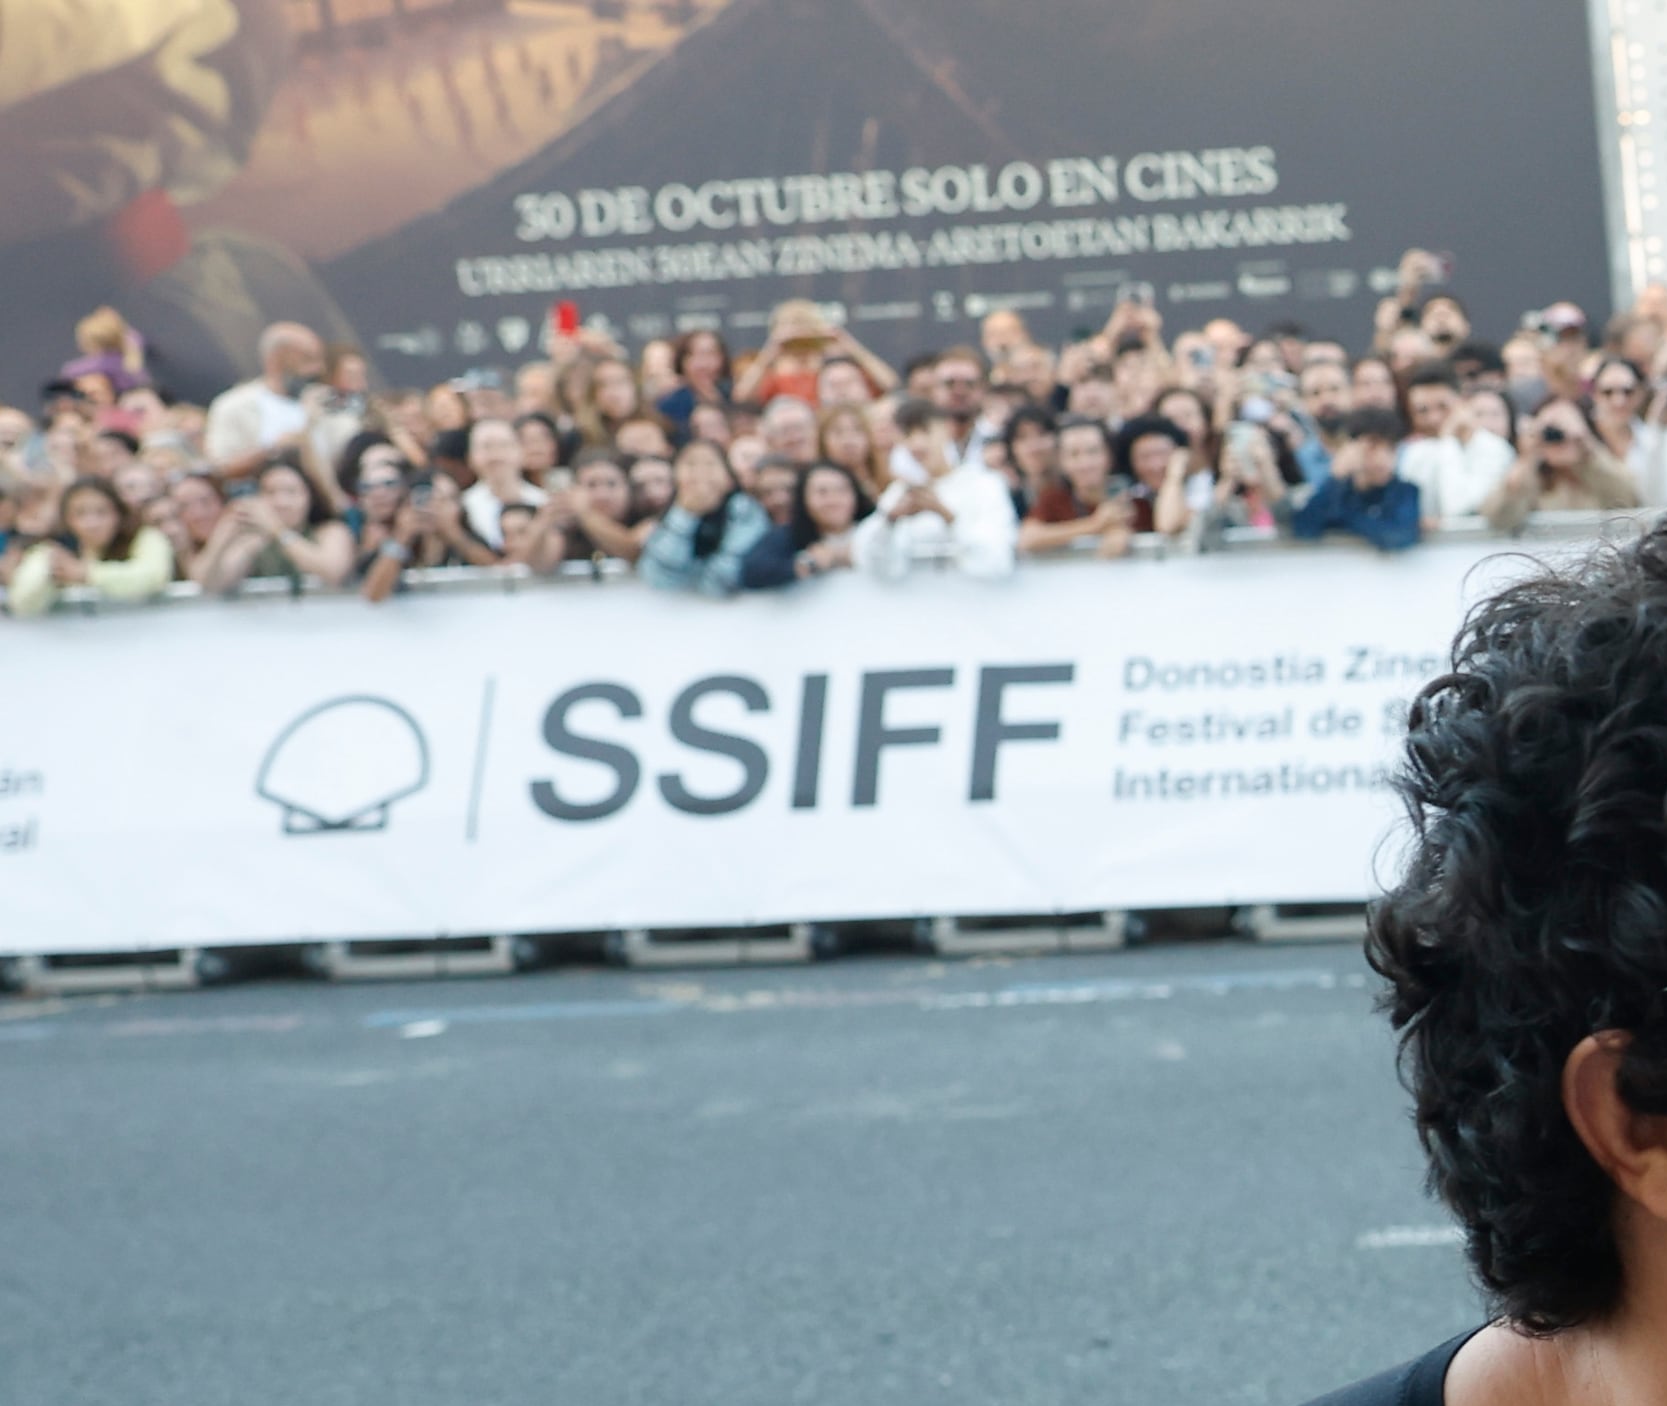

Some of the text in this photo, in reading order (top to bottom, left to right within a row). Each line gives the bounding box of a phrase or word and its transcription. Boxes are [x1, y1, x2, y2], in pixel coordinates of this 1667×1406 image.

[513, 145, 1279, 243] 30 DE OCTUBRE SOLO EN CINES
[1122, 648, 1452, 695] Donostia Zine
[529, 662, 1077, 826] SSIFF
[1117, 707, 1294, 747] Festival
[1309, 705, 1365, 740] de
[1112, 760, 1396, 802] Internationa
